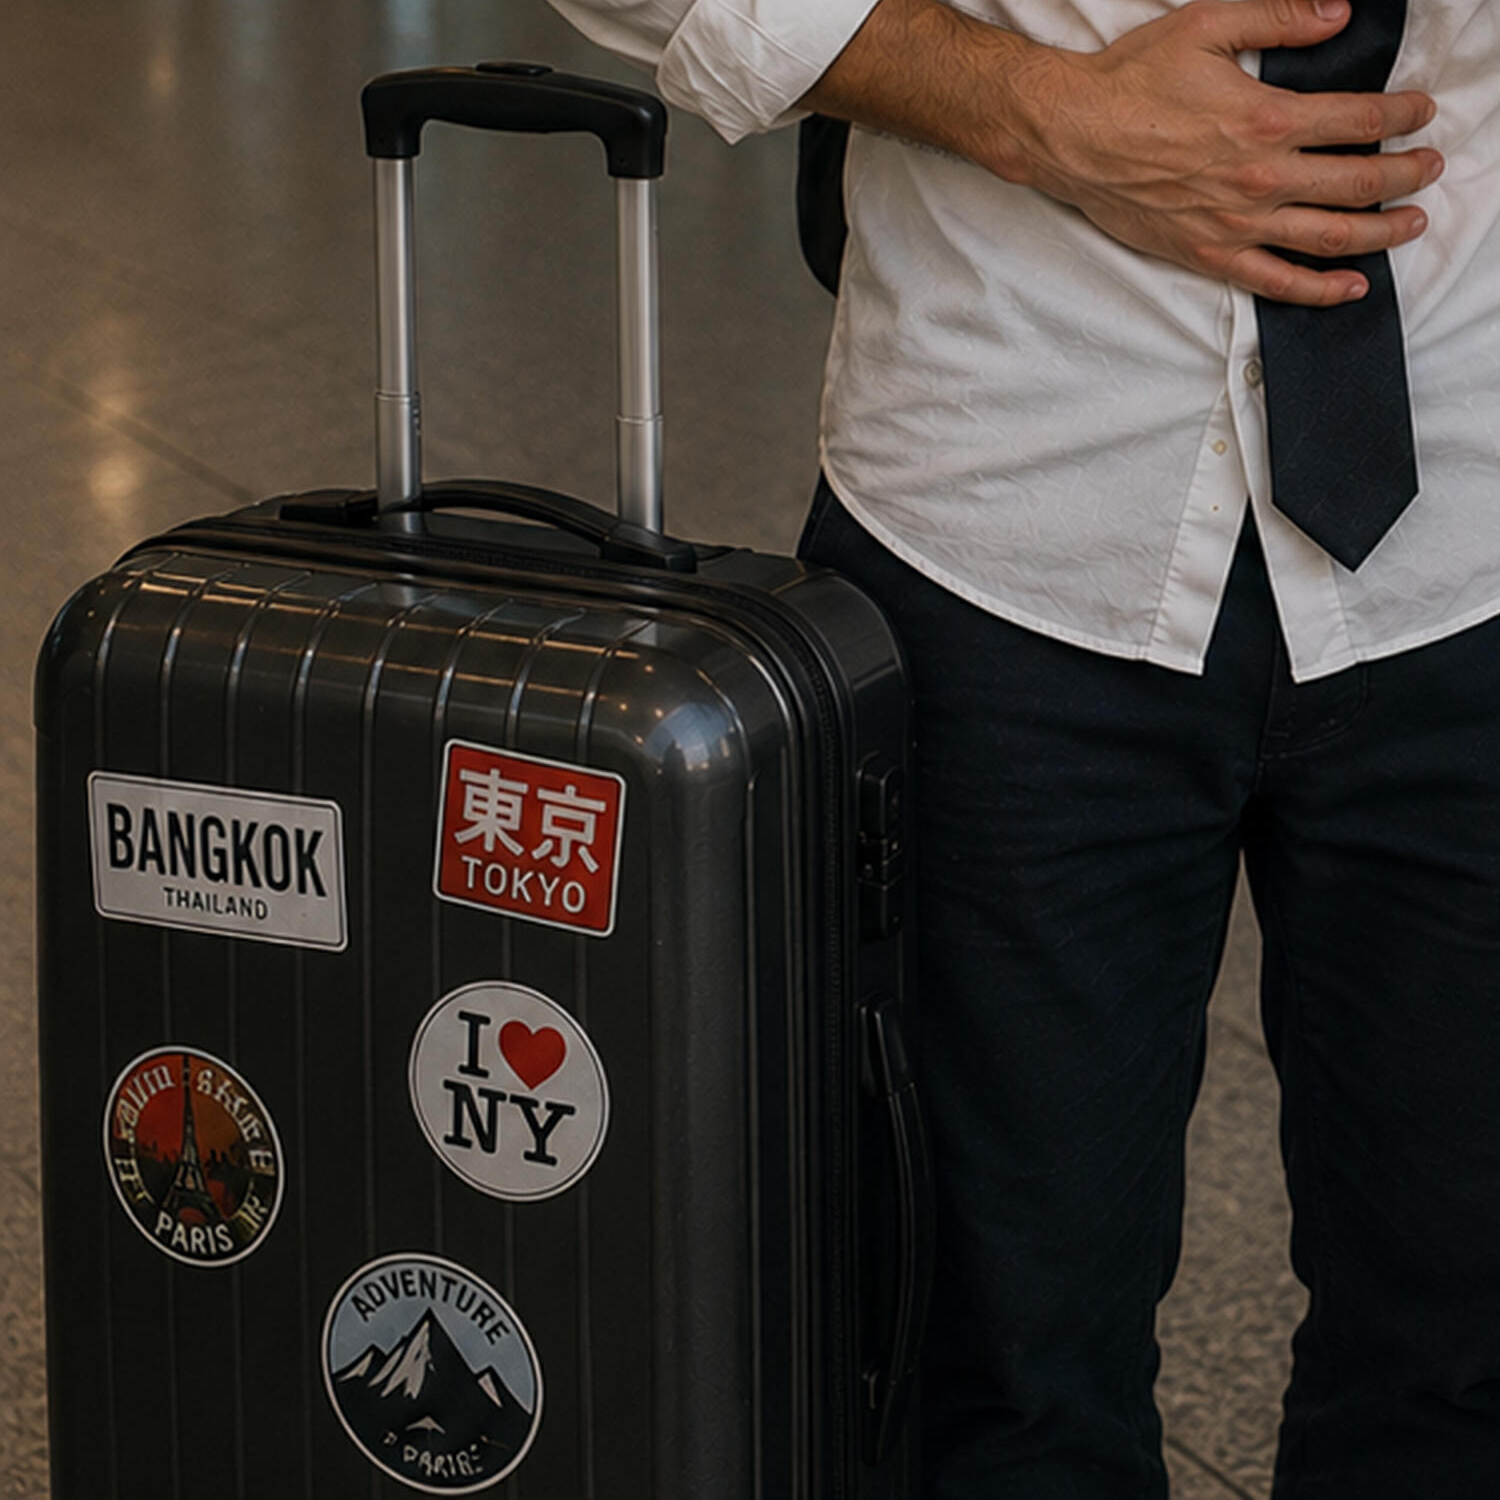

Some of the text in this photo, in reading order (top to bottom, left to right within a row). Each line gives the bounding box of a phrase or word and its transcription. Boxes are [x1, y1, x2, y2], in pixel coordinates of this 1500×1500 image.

[106, 802, 328, 898] BANGKOK
[454, 768, 606, 873] 東京
[163, 887, 269, 921] THAILAND
[461, 855, 585, 914] TOKYO
[458, 1010, 491, 1079] I
[443, 1079, 576, 1167] NY
[155, 1211, 234, 1254] PARIS
[351, 1269, 511, 1346] ADVENTURE
